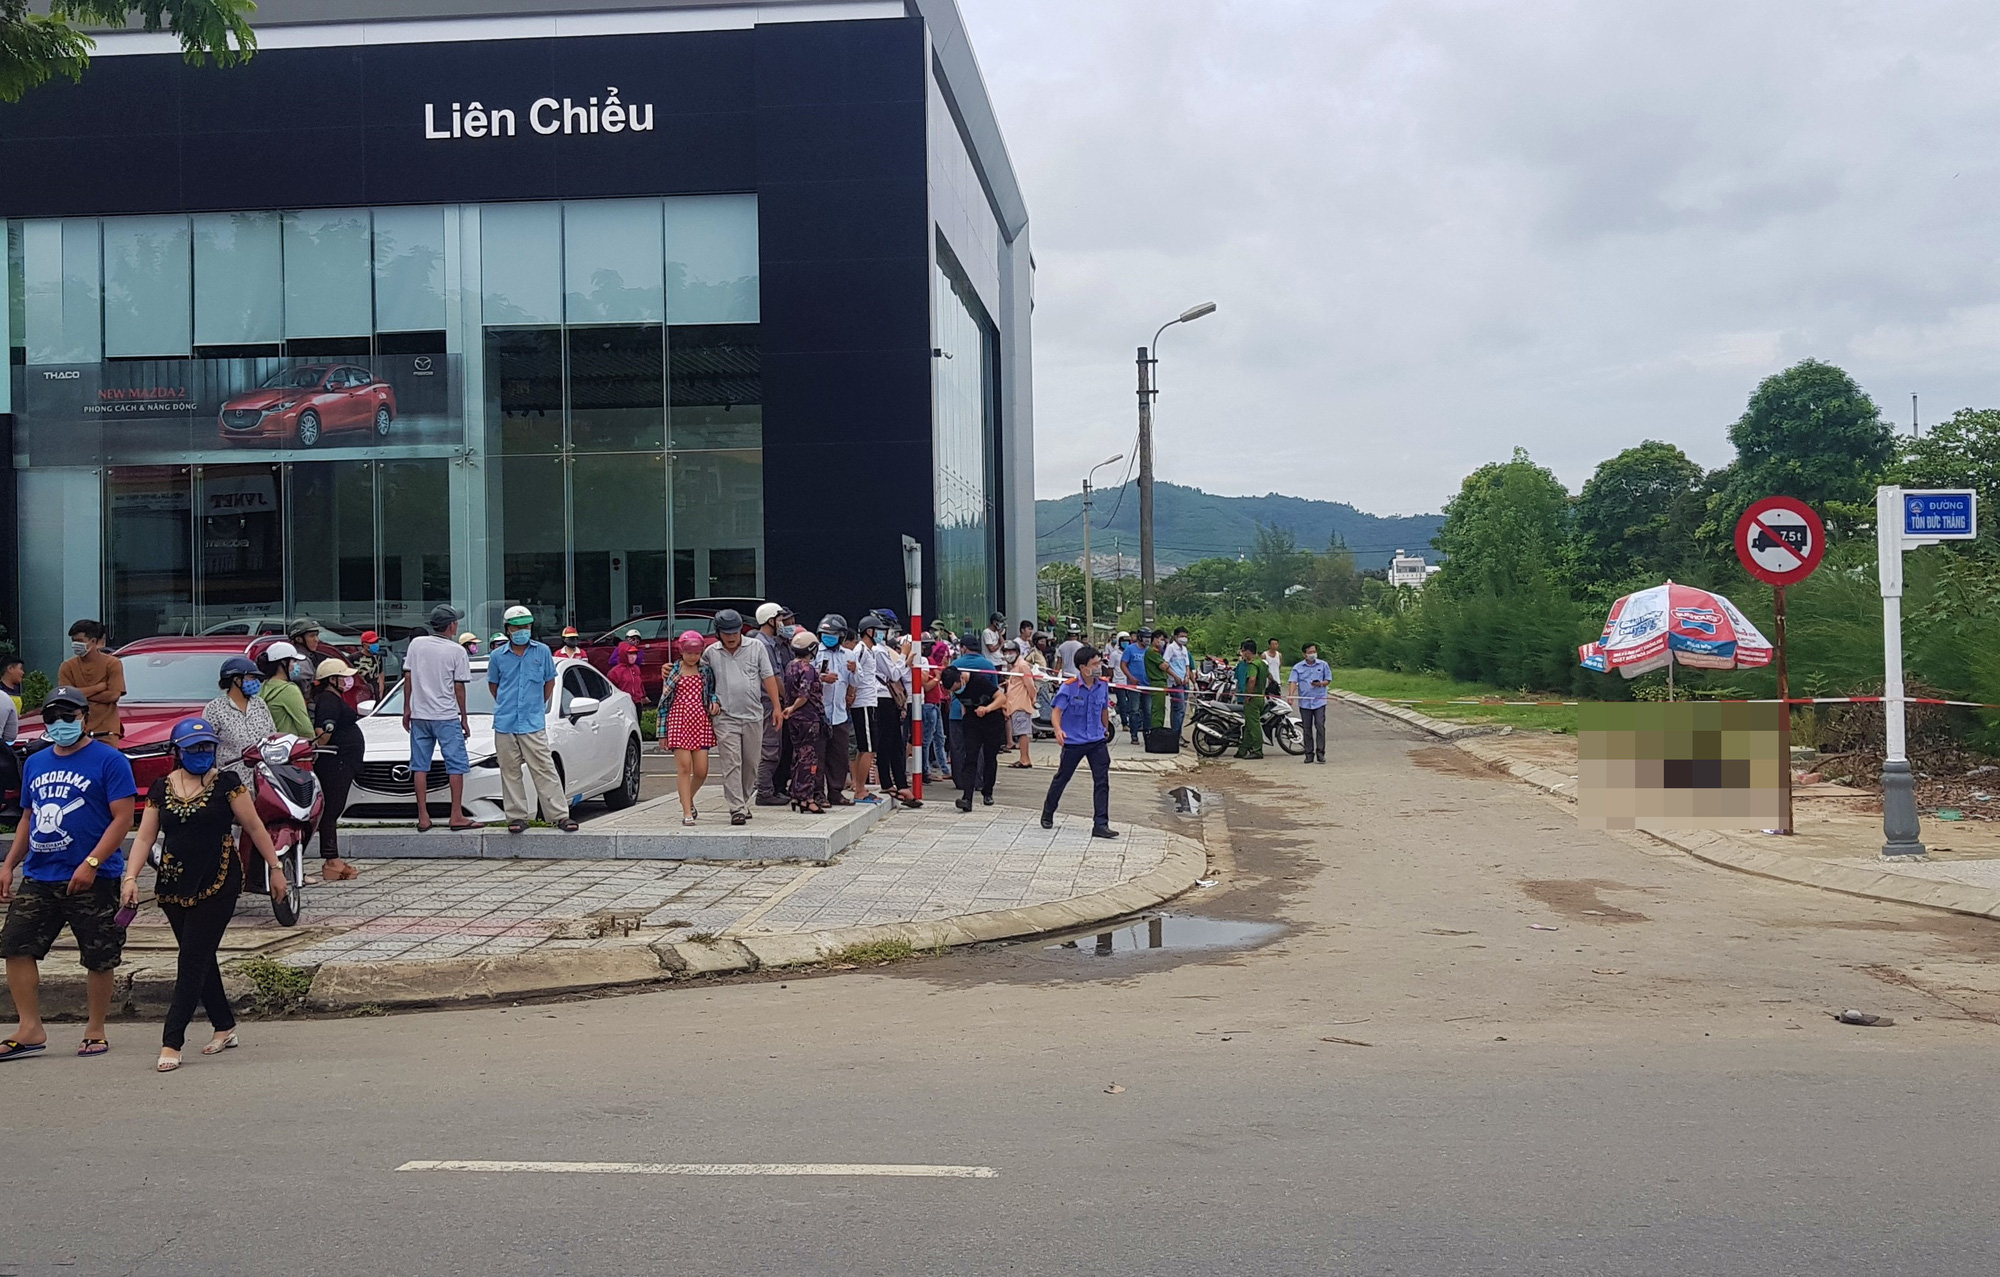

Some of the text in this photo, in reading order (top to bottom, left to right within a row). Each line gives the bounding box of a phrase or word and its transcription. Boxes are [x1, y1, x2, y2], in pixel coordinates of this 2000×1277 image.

[425, 86, 654, 139] Liên Chiểu
[43, 371, 80, 379] THACO
[98, 387, 185, 399] NEW MAZDA 2
[84, 405, 113, 413] PHONG
[115, 404, 137, 412] CÁCH
[172, 402, 197, 411] ĐỘNG
[1929, 499, 1964, 510] ĐƯỜNG
[1927, 513, 1941, 529] ĐỨC
[1942, 511, 1966, 529] THẮNG
[29, 770, 92, 793] YOKOHAMA
[38, 785, 71, 800] BLUE
